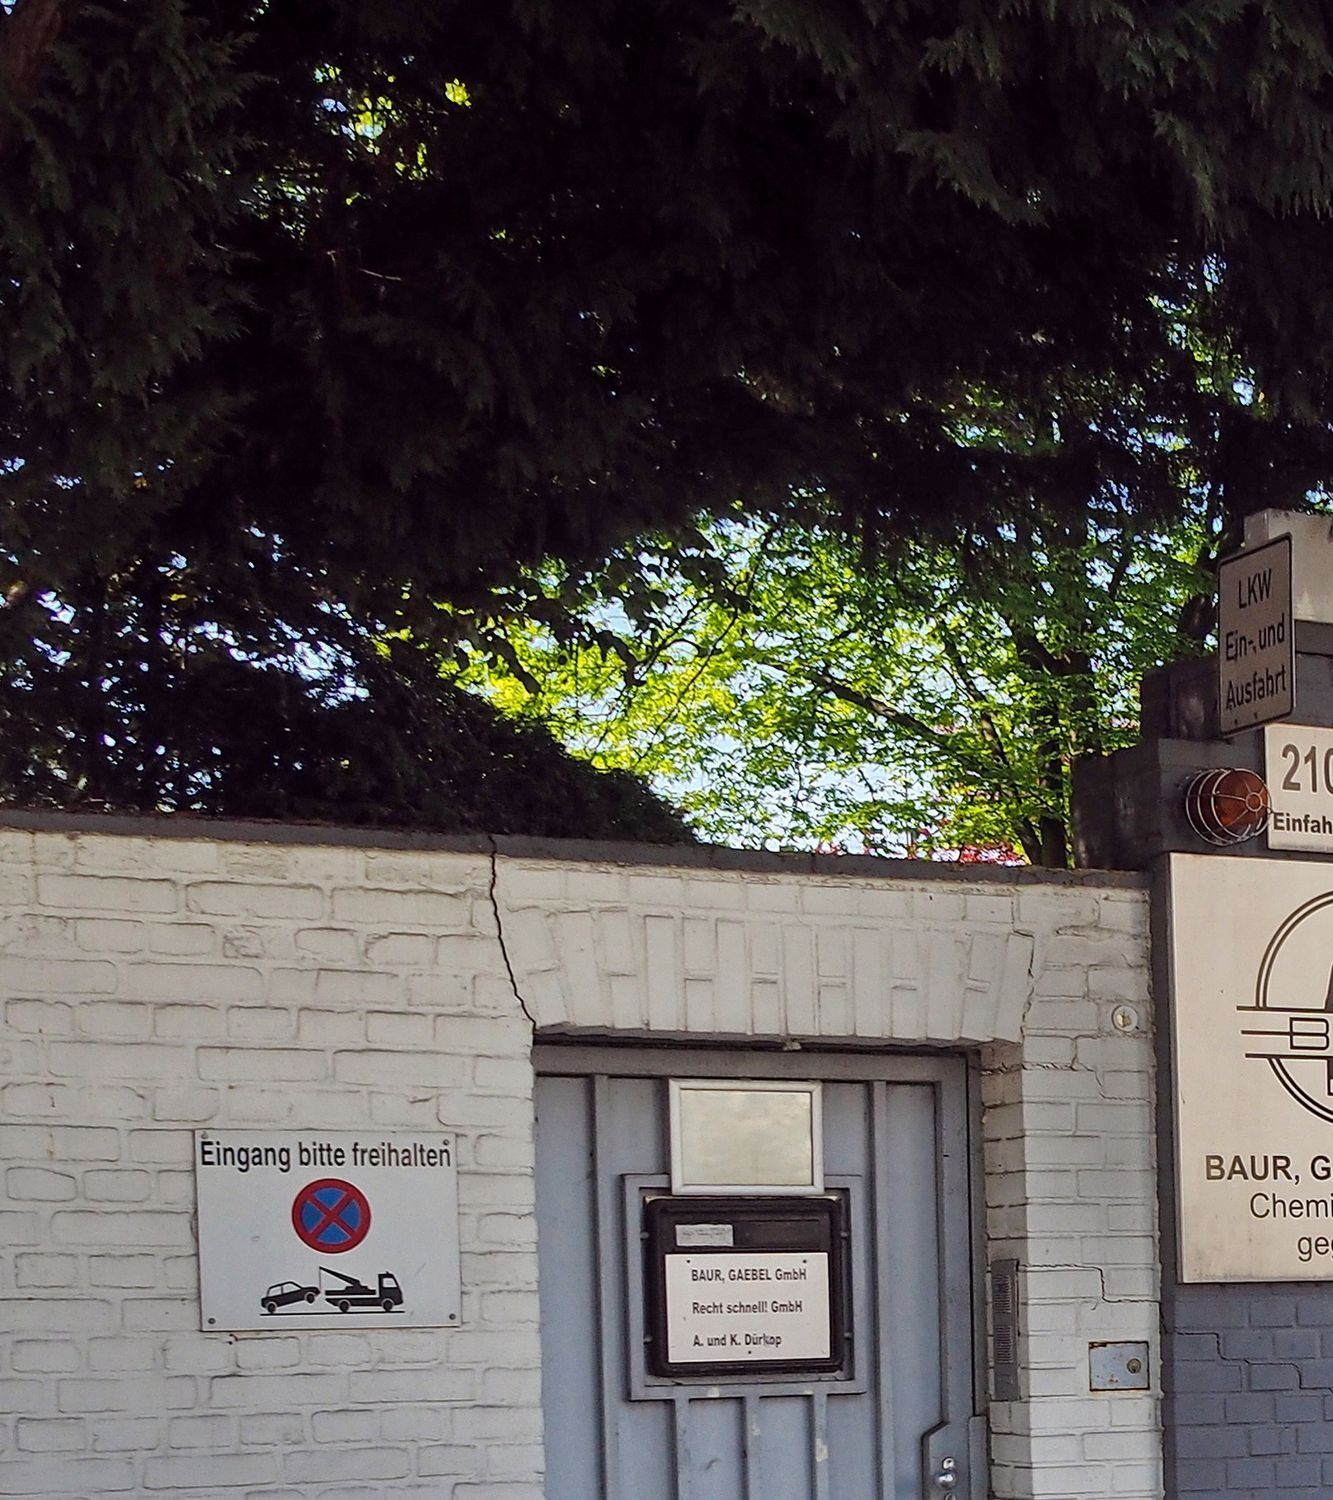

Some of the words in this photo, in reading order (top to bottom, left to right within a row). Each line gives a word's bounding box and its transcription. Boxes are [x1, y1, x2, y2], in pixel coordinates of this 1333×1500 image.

[1237, 568, 1272, 610] LKW
[1258, 613, 1286, 650] und
[1225, 664, 1287, 711] Ausfahrt
[200, 1141, 291, 1173] Eingang
[298, 1142, 346, 1167] bitte
[352, 1142, 451, 1167] freihalten
[1205, 1154, 1301, 1186] BAUR,
[691, 1269, 726, 1284] BAUR,
[728, 1268, 772, 1281] GAEBEL
[775, 1268, 807, 1281] GmbH
[692, 1302, 724, 1314] Recht
[726, 1301, 768, 1314] schnell!
[771, 1301, 803, 1313] GmbH
[693, 1335, 704, 1346] A.
[707, 1334, 727, 1346] und
[730, 1334, 741, 1346] K.
[744, 1333, 783, 1348] Dürkop
